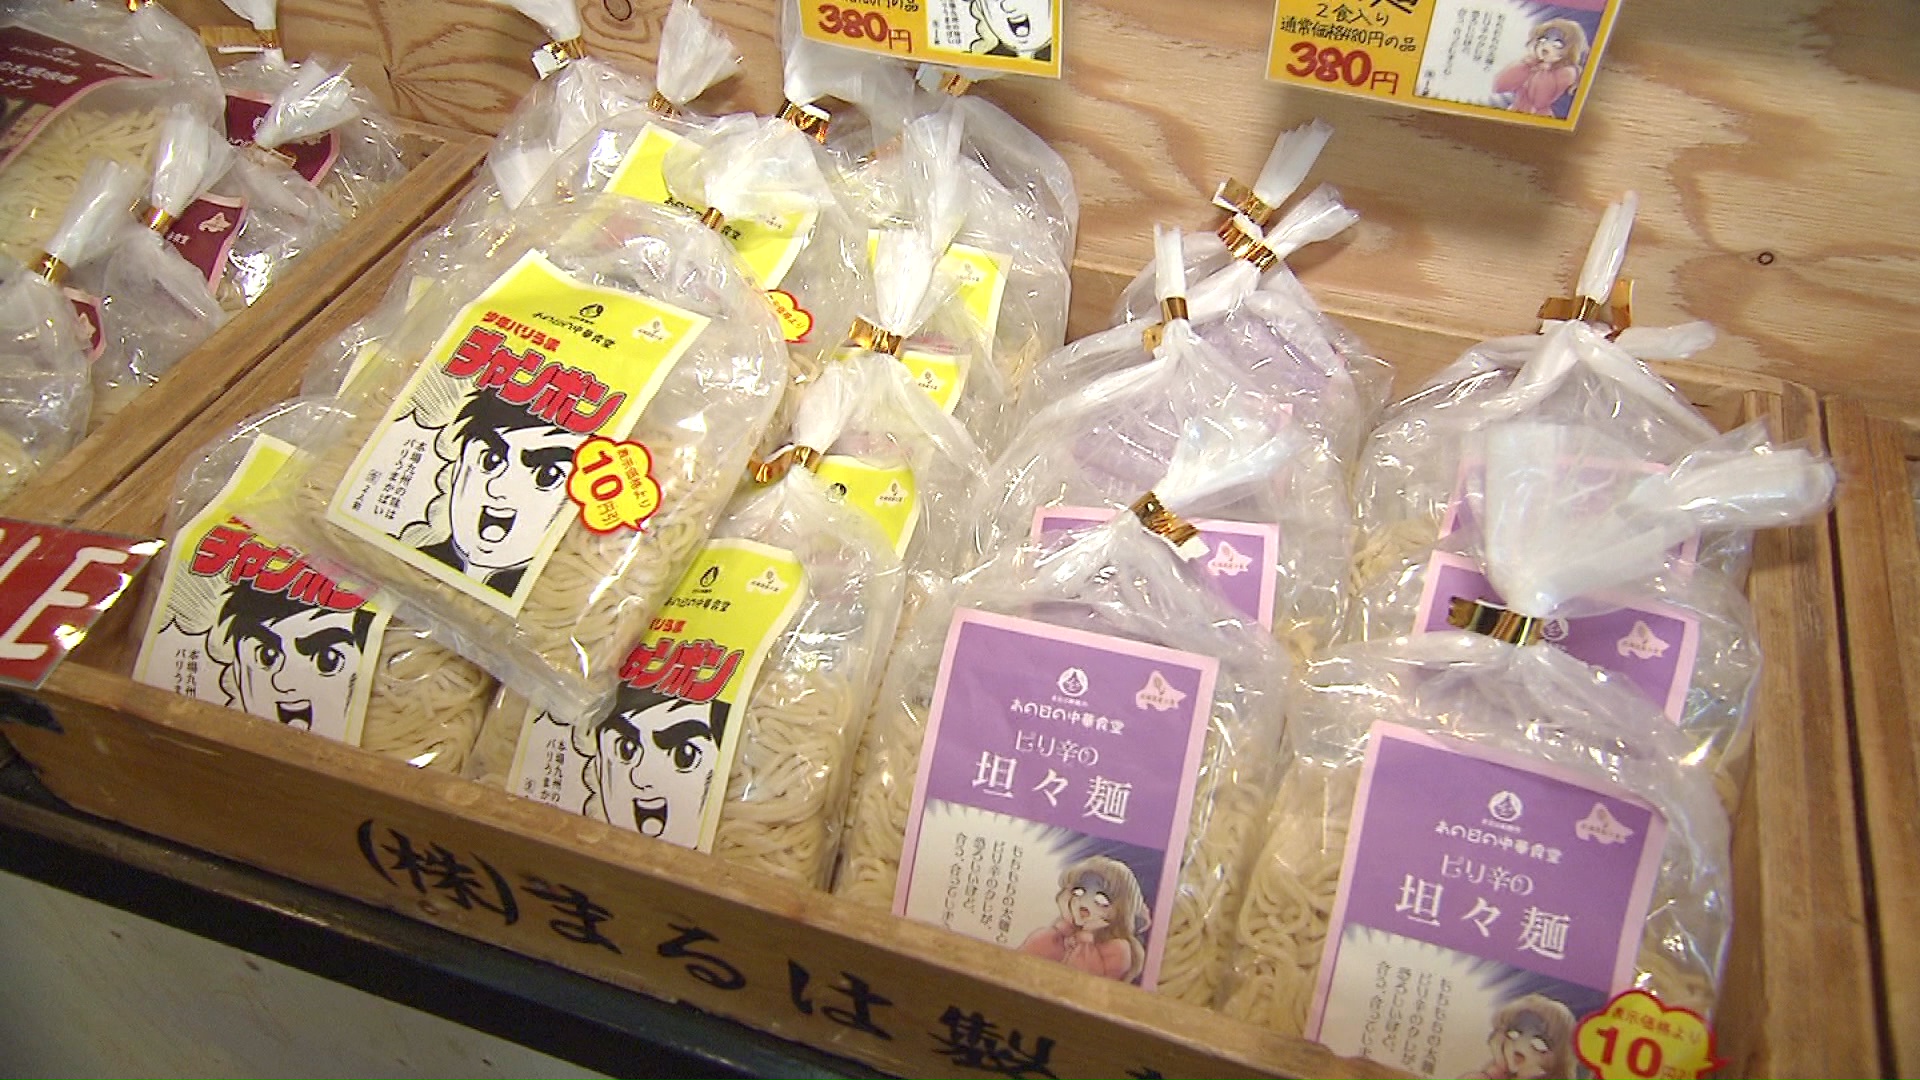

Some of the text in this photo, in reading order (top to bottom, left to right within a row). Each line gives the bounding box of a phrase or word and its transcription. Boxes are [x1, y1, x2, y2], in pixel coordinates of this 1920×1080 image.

[817, 4, 912, 53] 380円
[1286, 41, 1399, 96] 380円
[442, 326, 628, 434] チャンポン
[1010, 699, 1125, 736] あの日の中華食堂
[1014, 729, 1099, 768] ピリ辛の
[971, 751, 1133, 825] 坦々麺
[1434, 819, 1563, 864] あの日の中華食堂
[1441, 853, 1534, 896] ピリ辛の
[1394, 873, 1572, 960] 坦々麺
